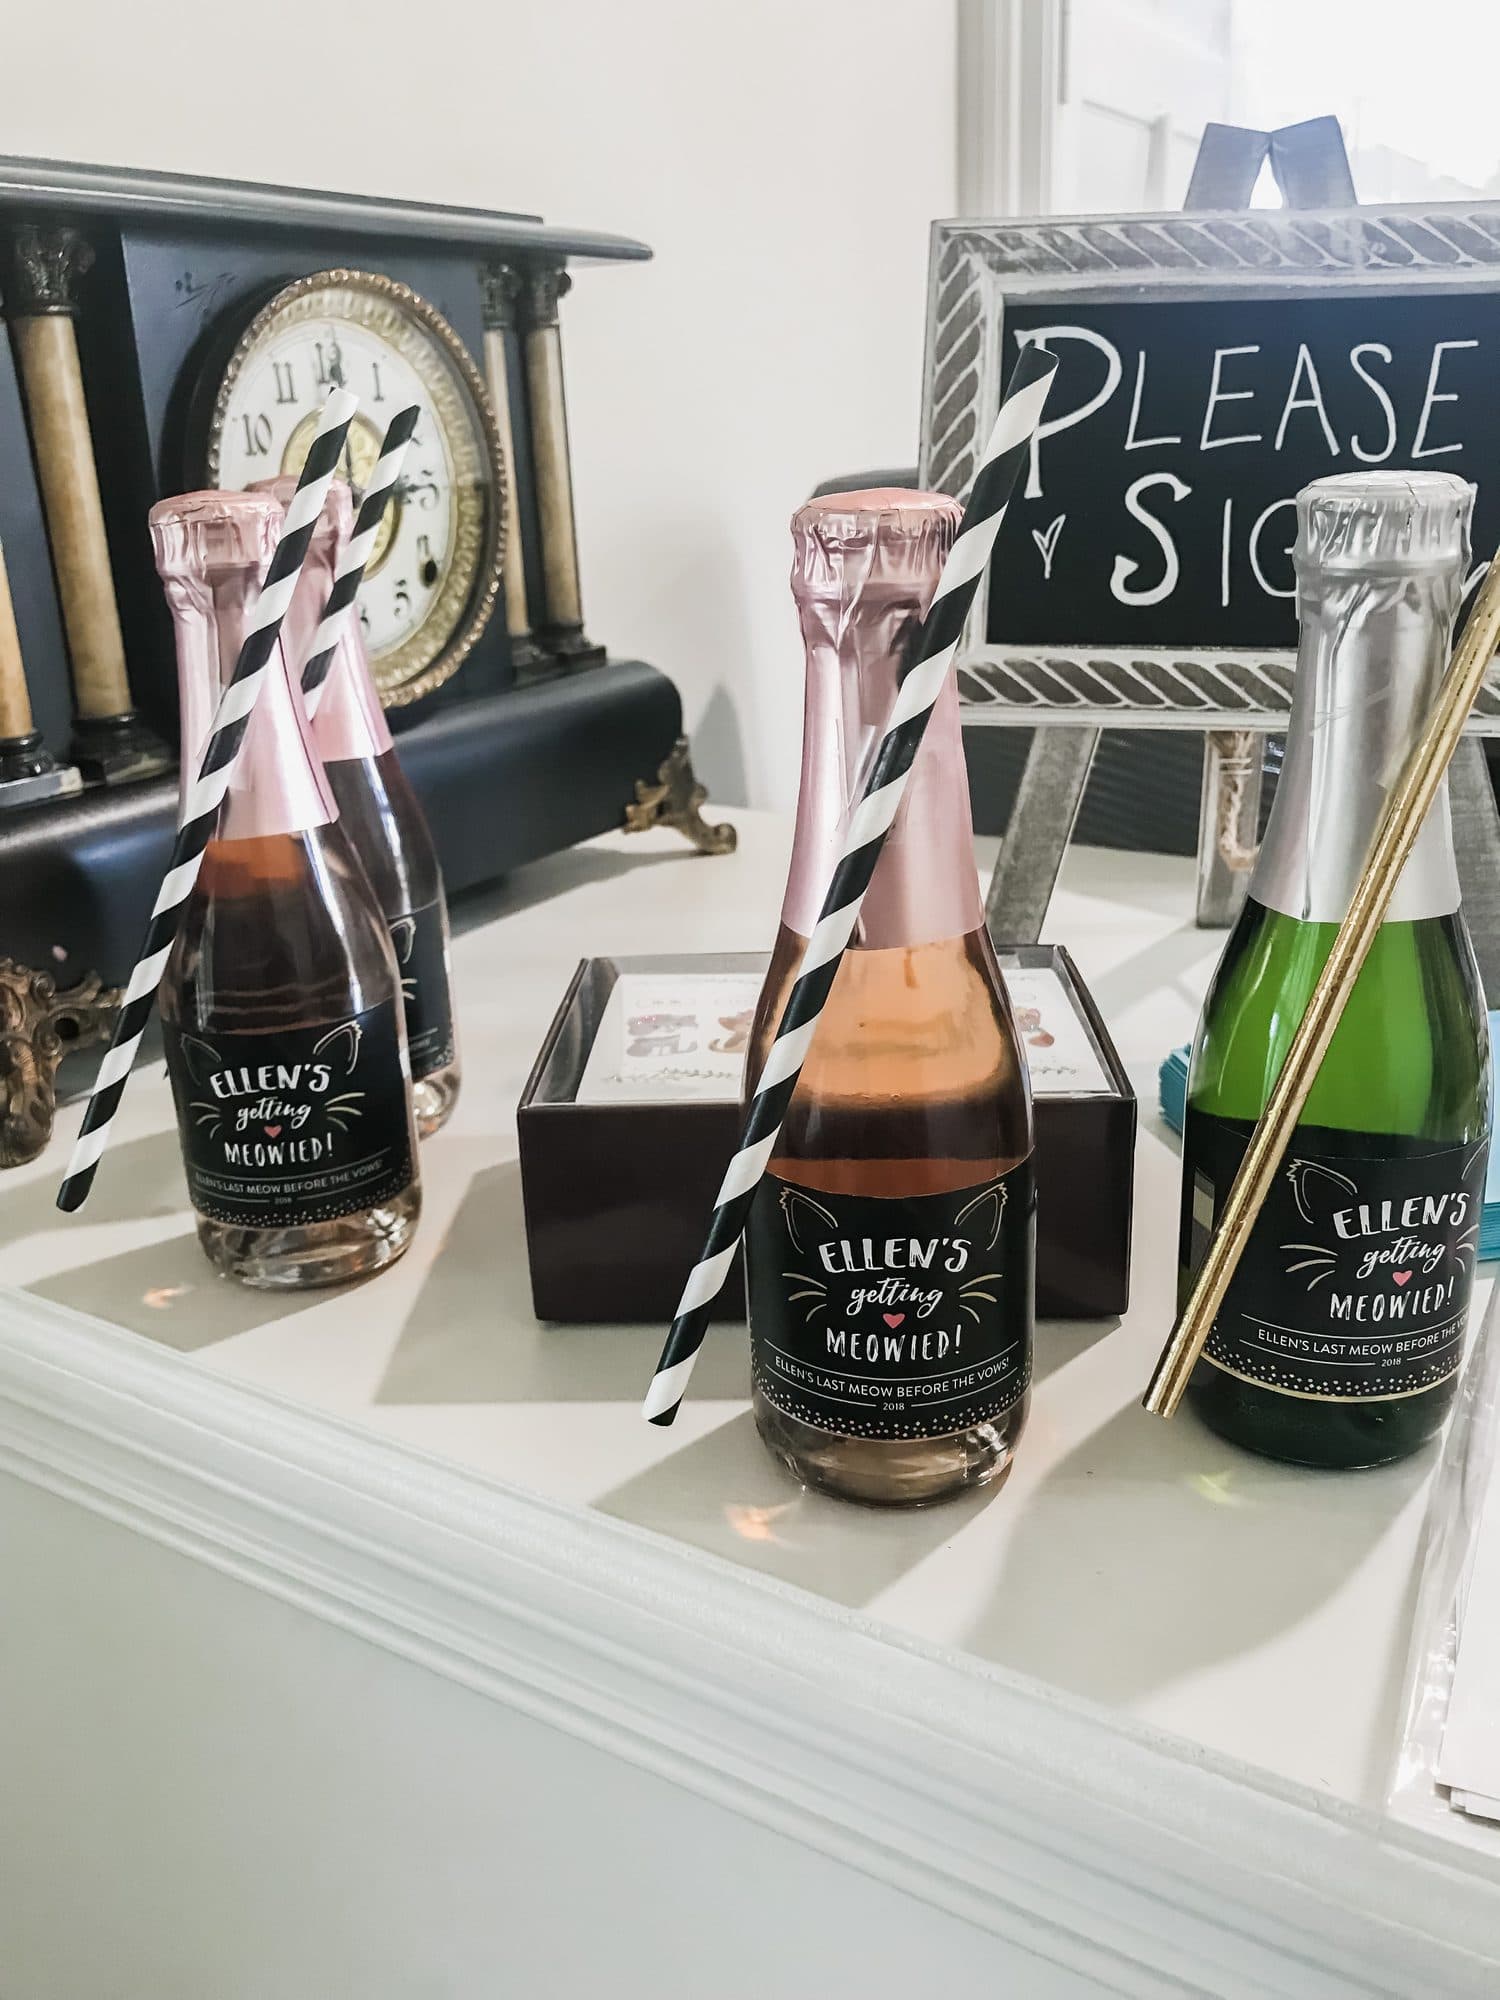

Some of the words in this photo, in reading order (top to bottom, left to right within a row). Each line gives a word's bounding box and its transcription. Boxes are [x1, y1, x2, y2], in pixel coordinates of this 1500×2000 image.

[272, 362, 298, 404] 11
[371, 361, 385, 402] 1
[1013, 325, 1479, 499] PLEASE
[242, 413, 273, 457] 10
[209, 1063, 333, 1099] ELLEN'S
[235, 1095, 312, 1131] getting
[223, 1132, 334, 1168] MEOWIED!
[223, 1182, 244, 1193] LAST
[246, 1183, 281, 1195] MEOW
[283, 1177, 329, 1194] BEFORE
[329, 1171, 350, 1184] THE
[1331, 1191, 1471, 1240] ELLEN'S
[817, 1237, 972, 1274] ELLEN'S
[1355, 1234, 1447, 1280] getting
[846, 1276, 944, 1319] getting
[1328, 1275, 1455, 1323] MEOWIED!
[825, 1323, 962, 1363] MEOWIED!
[1257, 1328, 1310, 1351] ELLEN'S
[1313, 1341, 1346, 1356] LAST
[1349, 1343, 1394, 1357] MEOW
[1395, 1333, 1440, 1353] BEFORE
[1440, 1321, 1457, 1339] THE
[774, 1355, 815, 1384] ELLEN'S
[815, 1375, 846, 1392] LAST
[848, 1382, 893, 1398] MEOW
[896, 1381, 950, 1398] BEFORE
[951, 1373, 976, 1390] THE
[976, 1356, 1010, 1381] VOWS!
[1381, 1356, 1402, 1367] 2018
[882, 1402, 906, 1411] 2018
